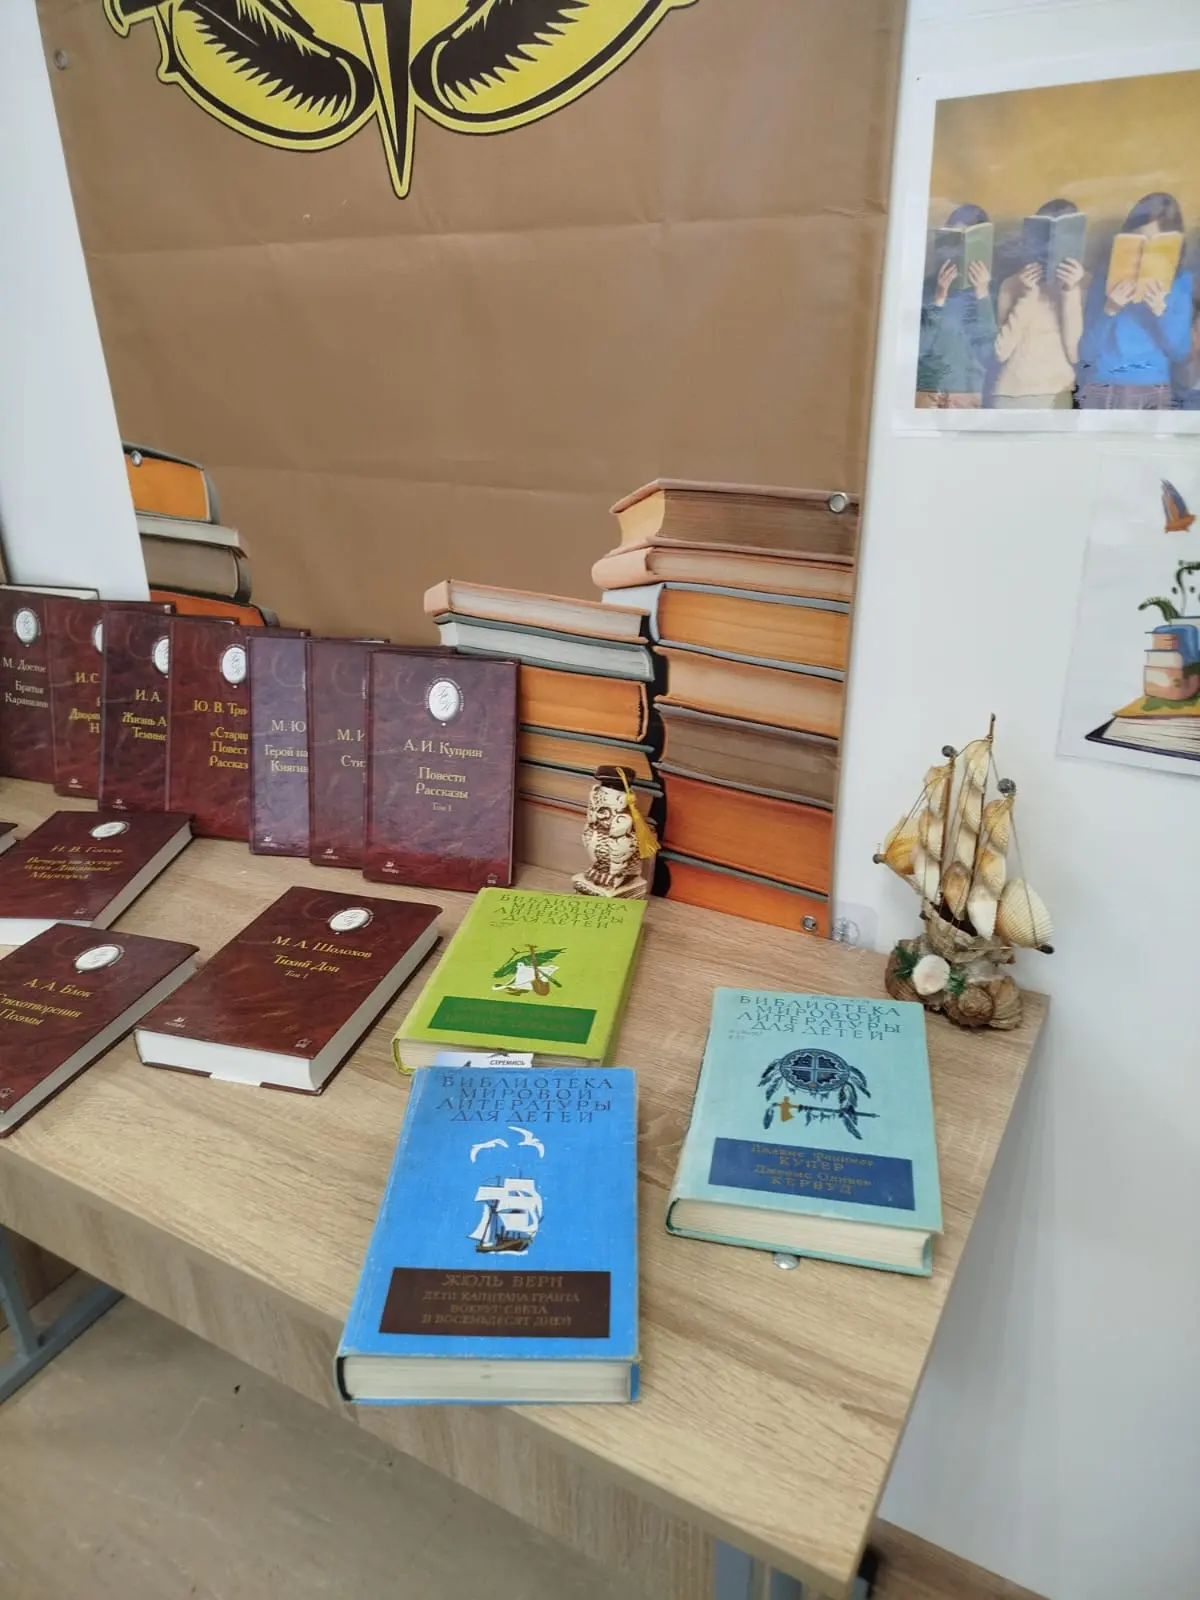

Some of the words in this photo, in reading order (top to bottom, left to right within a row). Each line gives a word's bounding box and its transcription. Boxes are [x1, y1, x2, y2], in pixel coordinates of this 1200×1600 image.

[194, 700, 211, 712] Ю.
[214, 702, 224, 713] В.
[271, 720, 287, 731] М.
[337, 729, 353, 740] М.
[404, 739, 418, 751] А.
[421, 740, 435, 752] И.
[440, 741, 482, 758] Куприн
[419, 766, 466, 783] Повести
[415, 782, 468, 799] Рассказы
[500, 894, 628, 911] БИБЛИОТЕКА
[272, 936, 291, 946] М.
[293, 940, 308, 949] А.
[312, 942, 372, 958] Шолохов
[274, 954, 312, 968] Тихий
[310, 961, 340, 973] Дон
[24, 978, 39, 988] А.
[40, 981, 56, 992] А.
[60, 984, 93, 997] Блок
[740, 995, 901, 1016] БИБЛИОТЕКА
[756, 1005, 881, 1023] МИРОВОЙ
[737, 1011, 901, 1033] ЛИТЕРАТУРЫ
[752, 1021, 794, 1033] ДЛЯ
[802, 1025, 884, 1041] ДЕТЕЙ
[442, 1076, 613, 1090] БИБЛИОТЕКА
[461, 1088, 592, 1100] МИРОВОЙ
[436, 1099, 611, 1112] ЛИТЕРАТУРЫ
[451, 1110, 499, 1122] ДЛЯ
[505, 1111, 593, 1123] ДЕТЕЙ
[512, 1275, 564, 1288] ВЕРН
